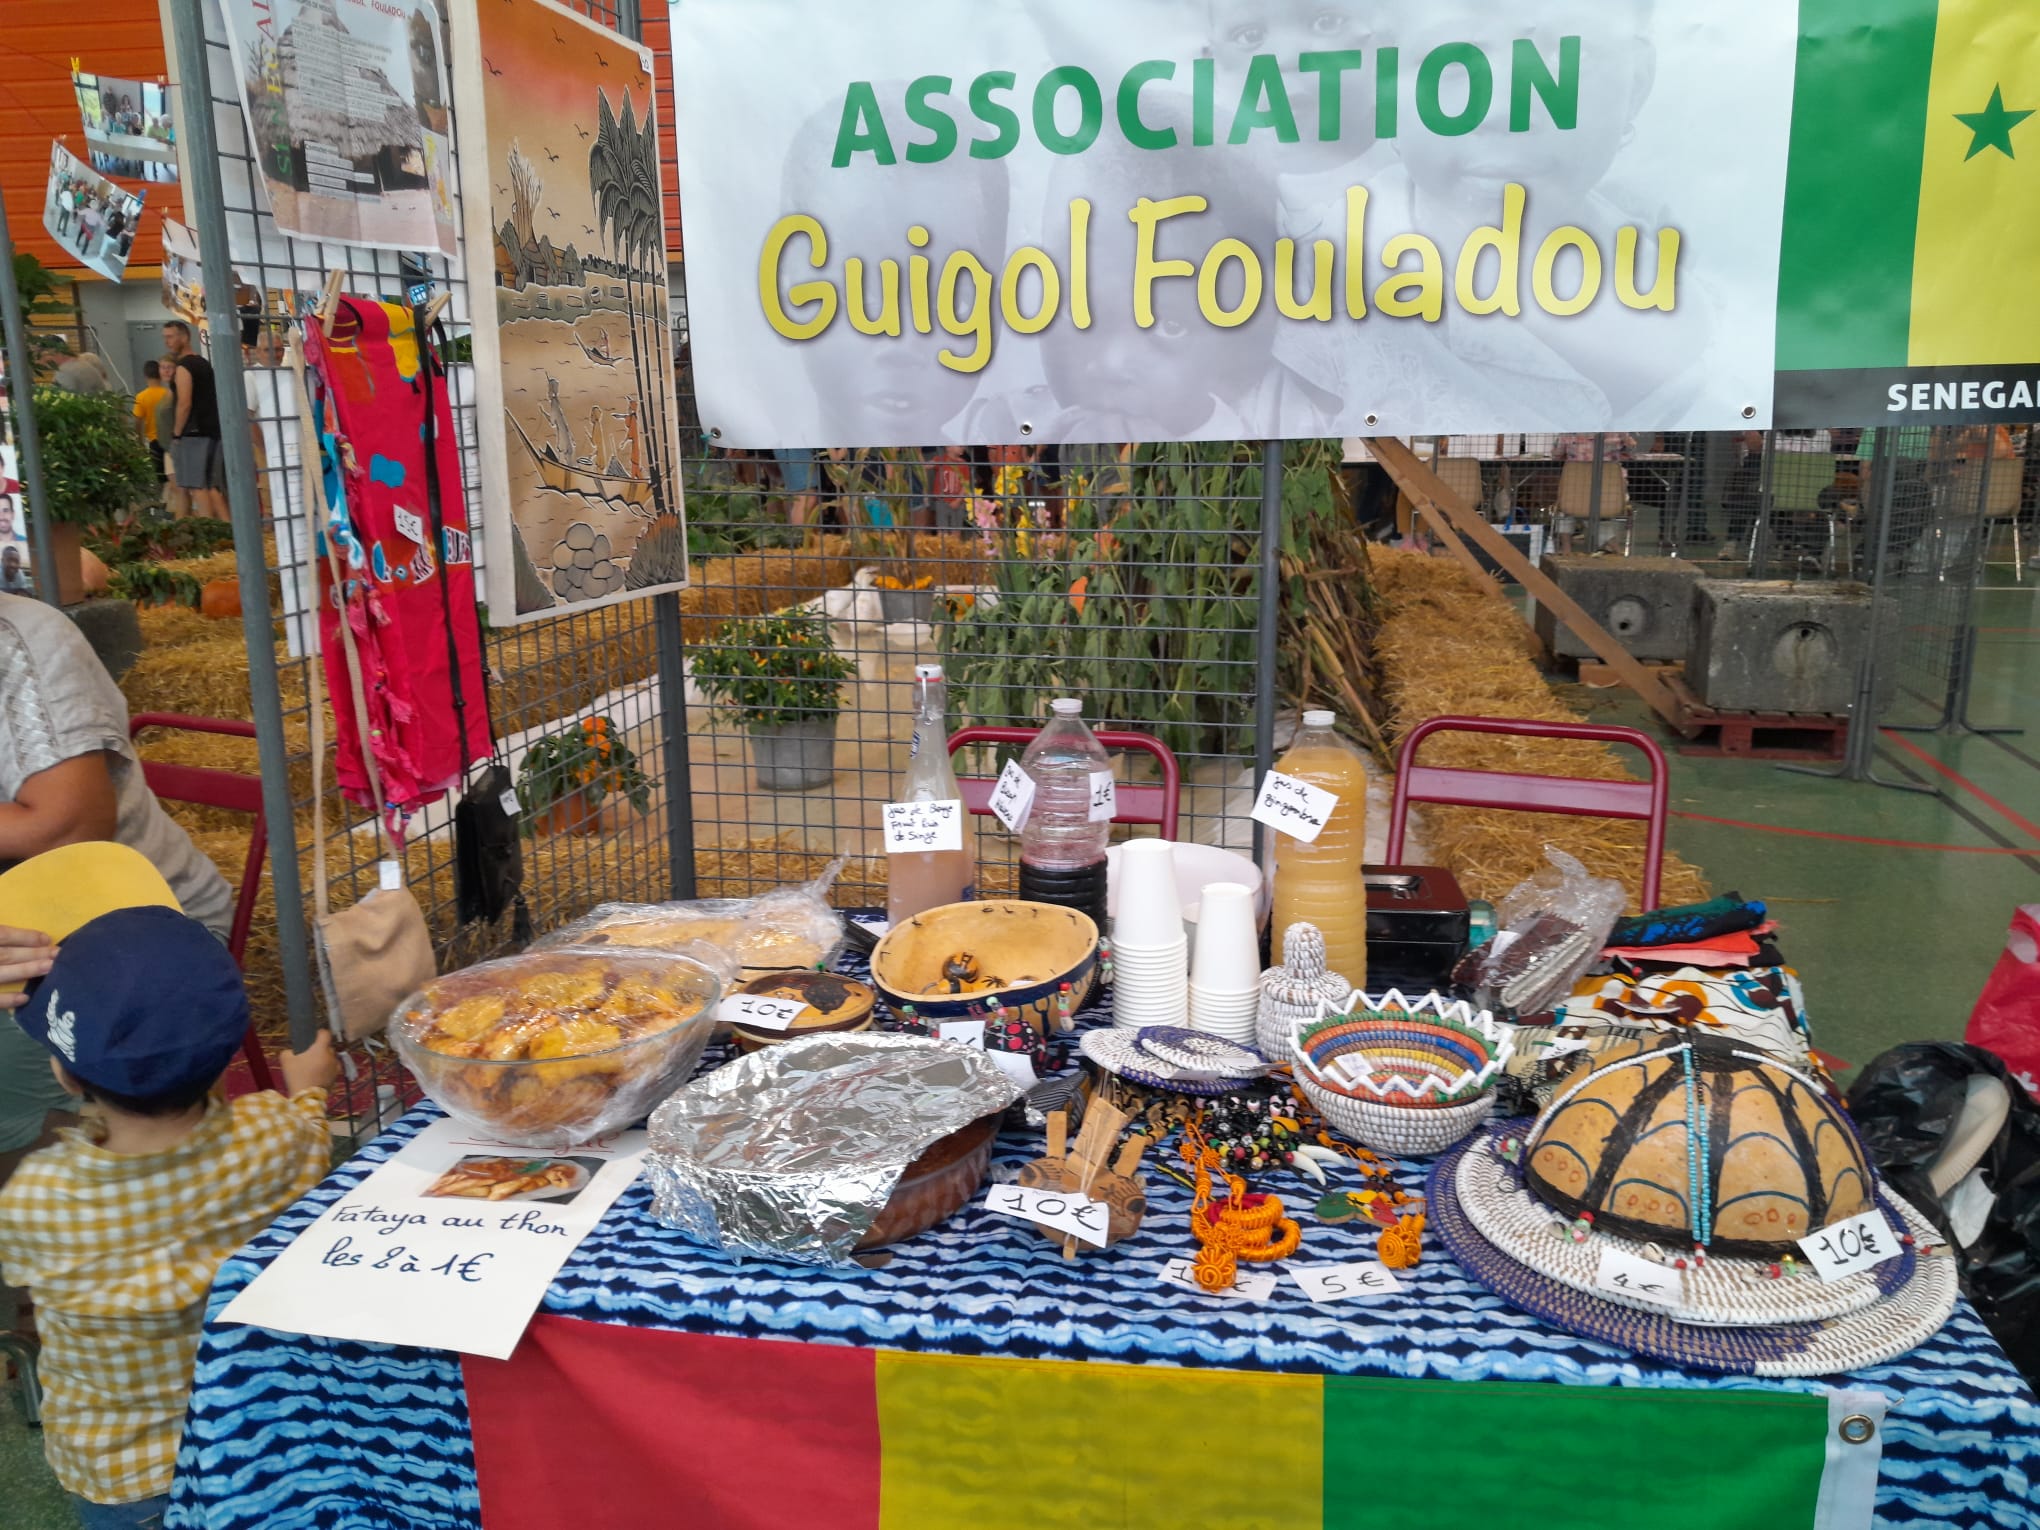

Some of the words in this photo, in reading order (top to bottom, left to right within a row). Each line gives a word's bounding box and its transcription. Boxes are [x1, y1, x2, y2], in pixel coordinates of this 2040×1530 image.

[831, 35, 1581, 168] ASSOCIATION
[758, 198, 1092, 373] Guigol
[1128, 183, 1681, 328] Fouladou
[1887, 380, 2040, 411] SENEGA
[741, 1001, 794, 1020] 10€
[331, 1205, 427, 1236] Fataya
[442, 1217, 485, 1228] au
[500, 1210, 568, 1237] thon
[1002, 1193, 1103, 1232] 10€
[321, 1236, 363, 1267] les
[1818, 1223, 1881, 1266] 10€
